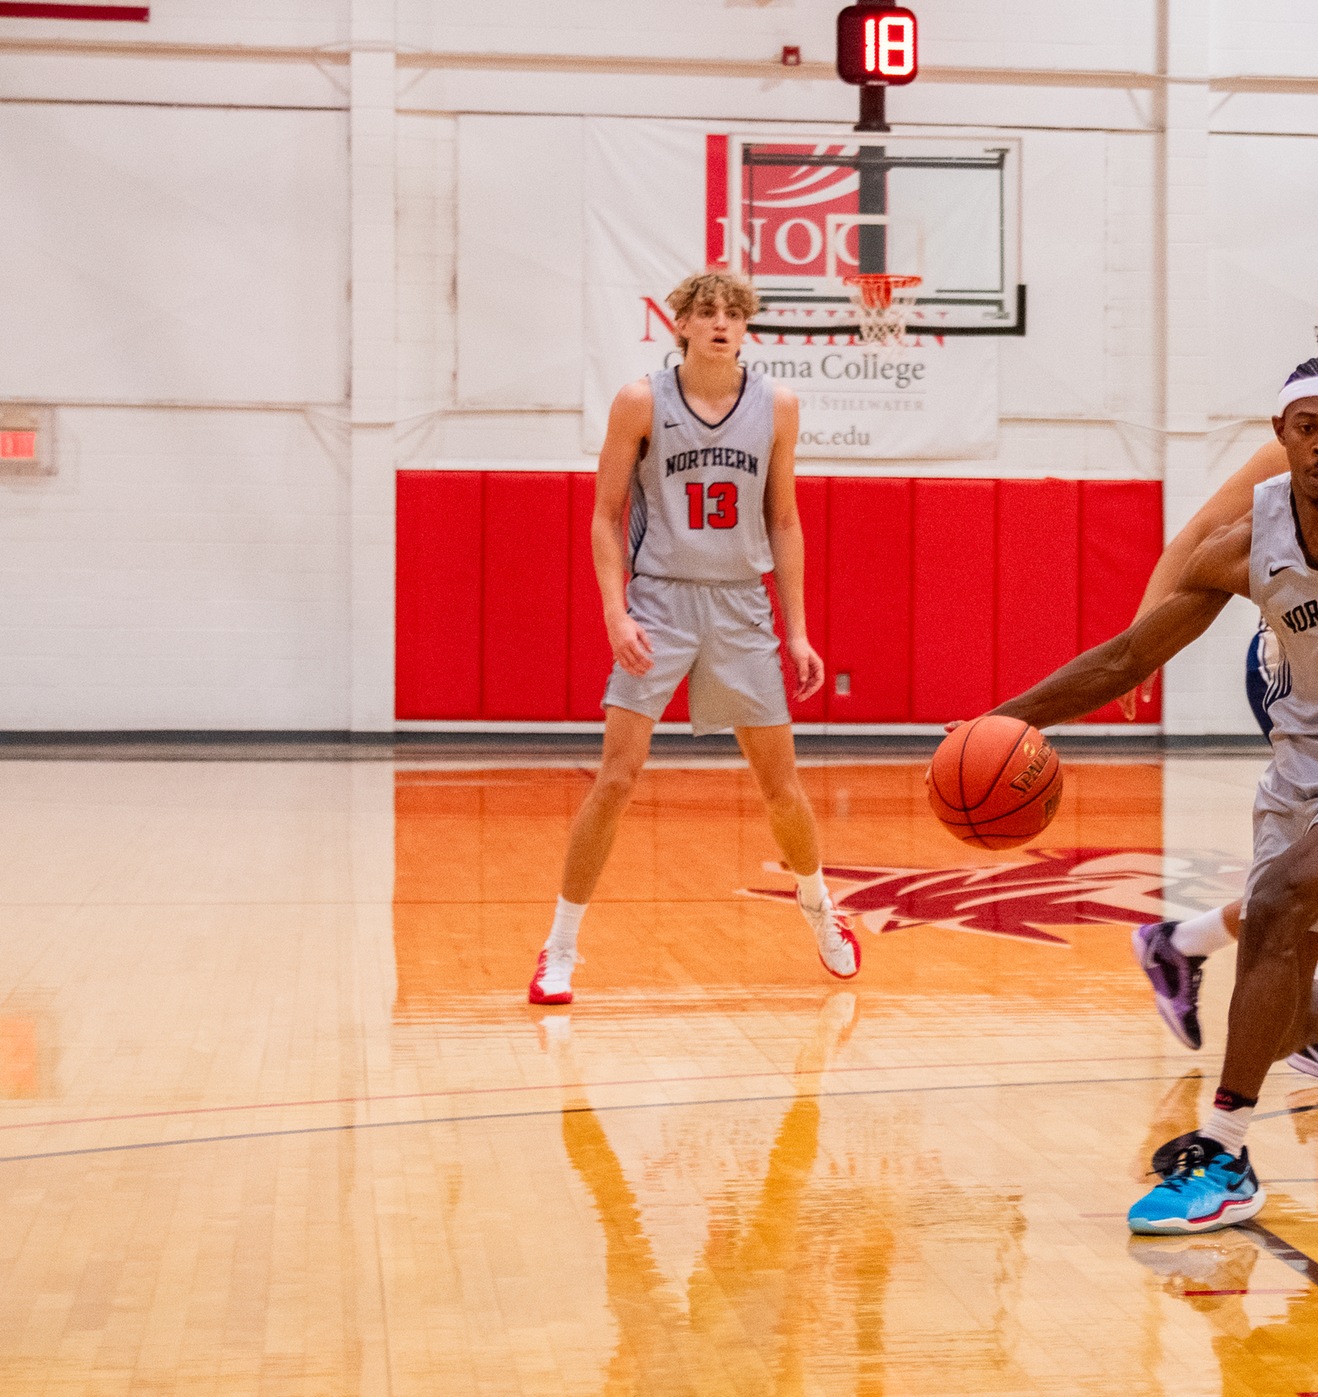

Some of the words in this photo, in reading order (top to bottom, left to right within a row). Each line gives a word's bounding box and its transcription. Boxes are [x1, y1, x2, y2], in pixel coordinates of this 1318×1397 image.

[865, 16, 914, 75] 18
[821, 353, 926, 389] College
[800, 425, 870, 446] oc.edu
[665, 447, 758, 478] NORTHERN
[686, 481, 738, 530] 13
